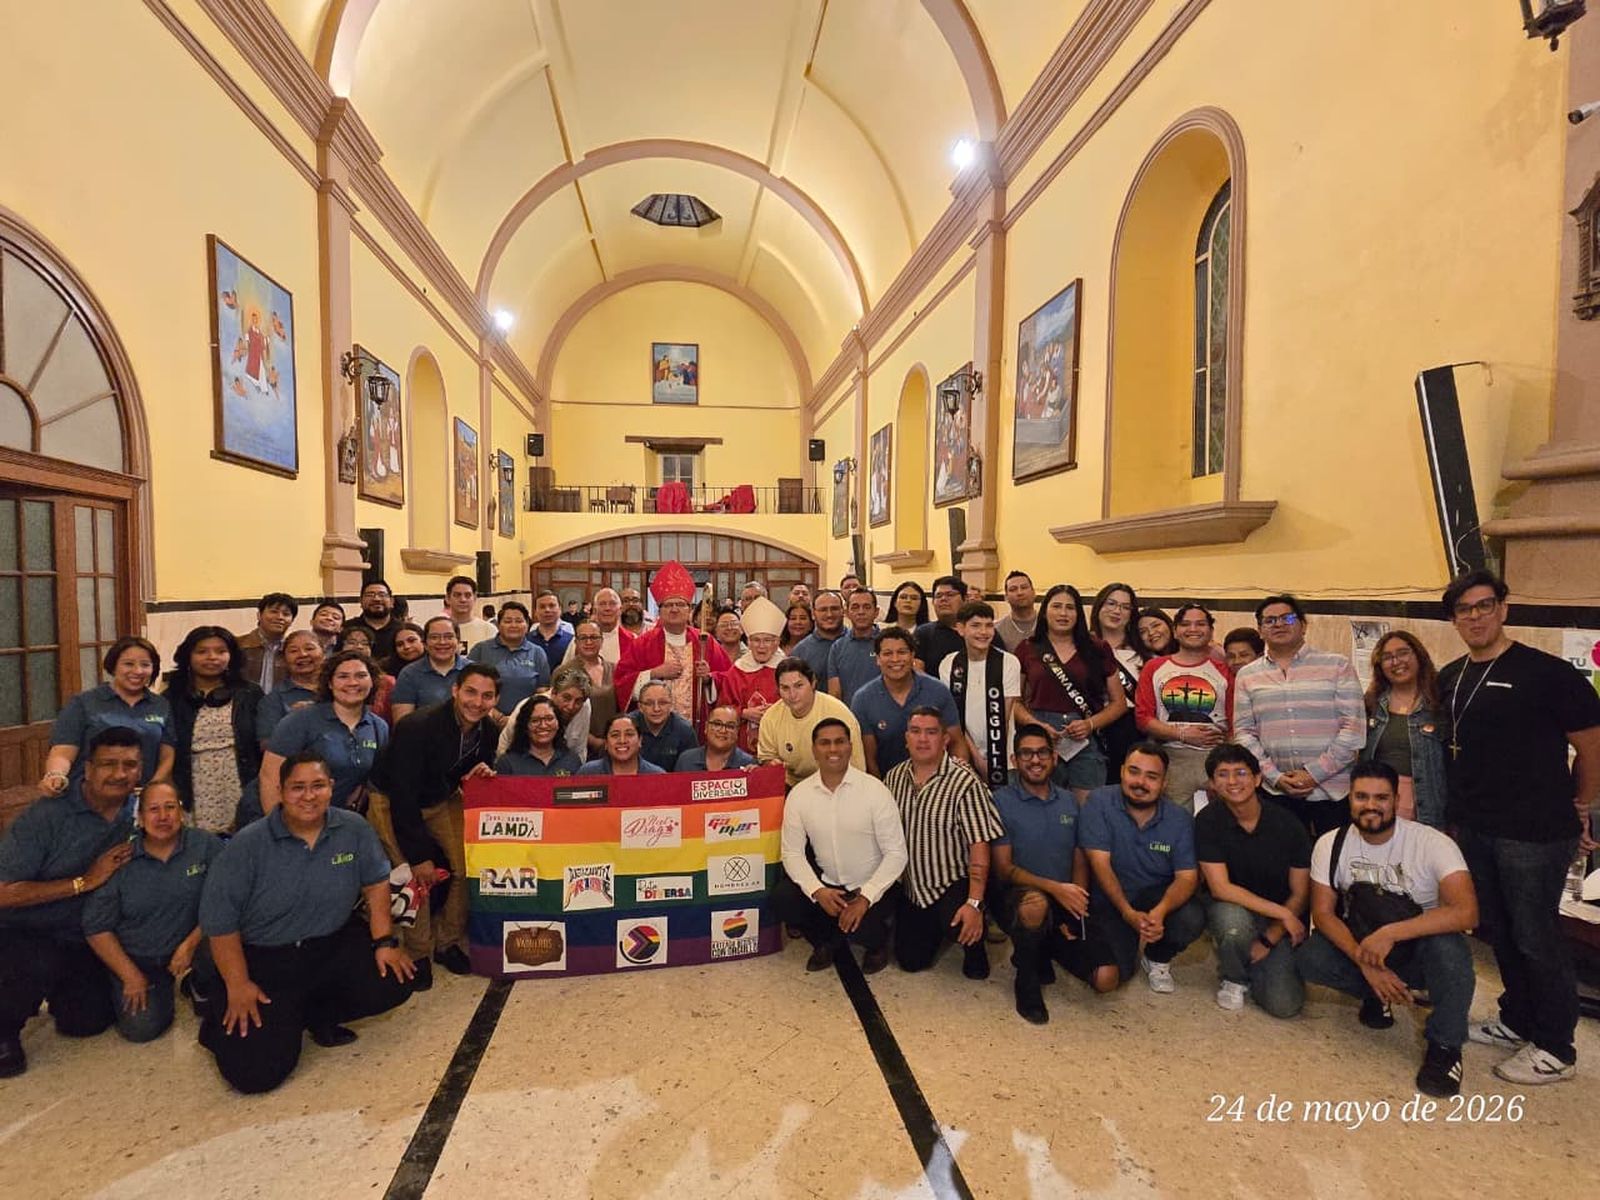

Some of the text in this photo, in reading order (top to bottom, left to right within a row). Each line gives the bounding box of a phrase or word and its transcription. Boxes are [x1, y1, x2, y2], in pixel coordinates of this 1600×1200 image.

[988, 687, 1003, 784] ORGULLO
[693, 780, 743, 792] ESPACIO
[693, 788, 746, 799] DIVERSIDAD
[480, 868, 536, 889] RAR
